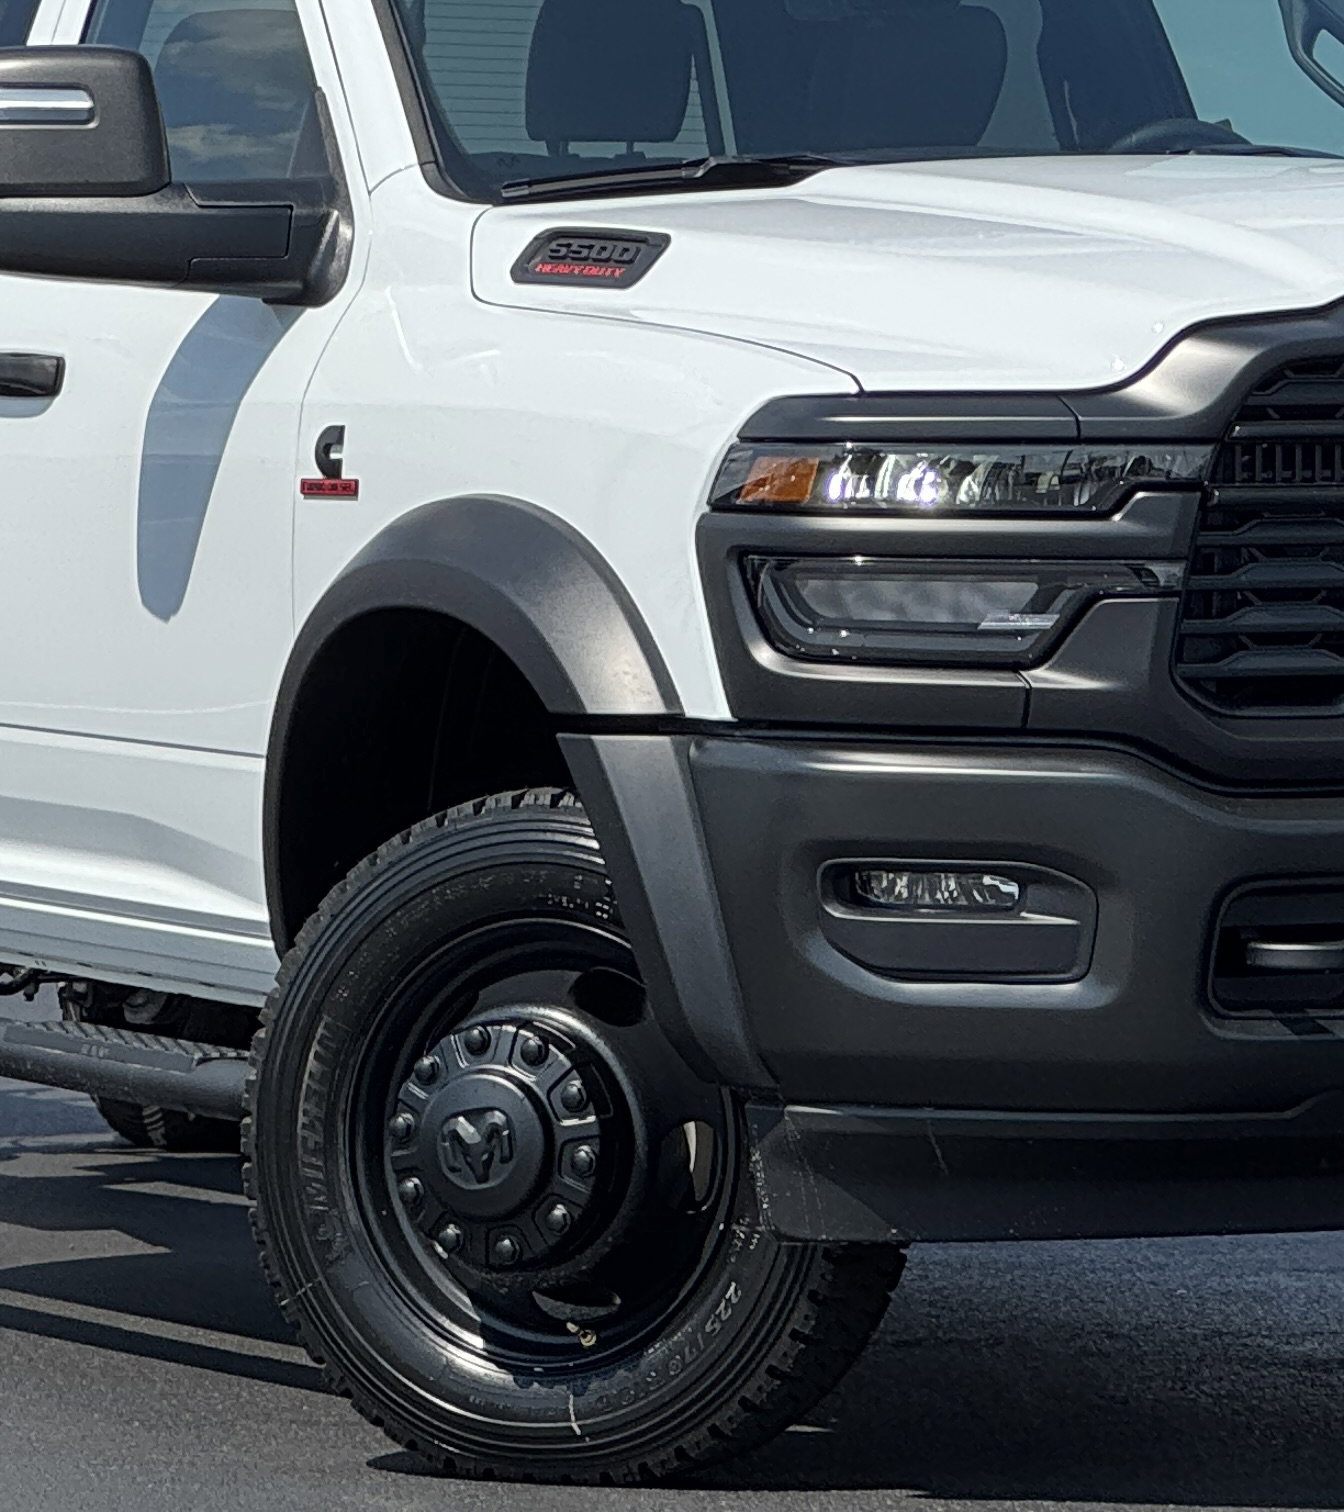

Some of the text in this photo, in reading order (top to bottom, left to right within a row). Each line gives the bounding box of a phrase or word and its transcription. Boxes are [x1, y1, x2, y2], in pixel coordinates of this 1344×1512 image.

[548, 242, 641, 264] 5500
[535, 263, 626, 277] HEAVY DUTY
